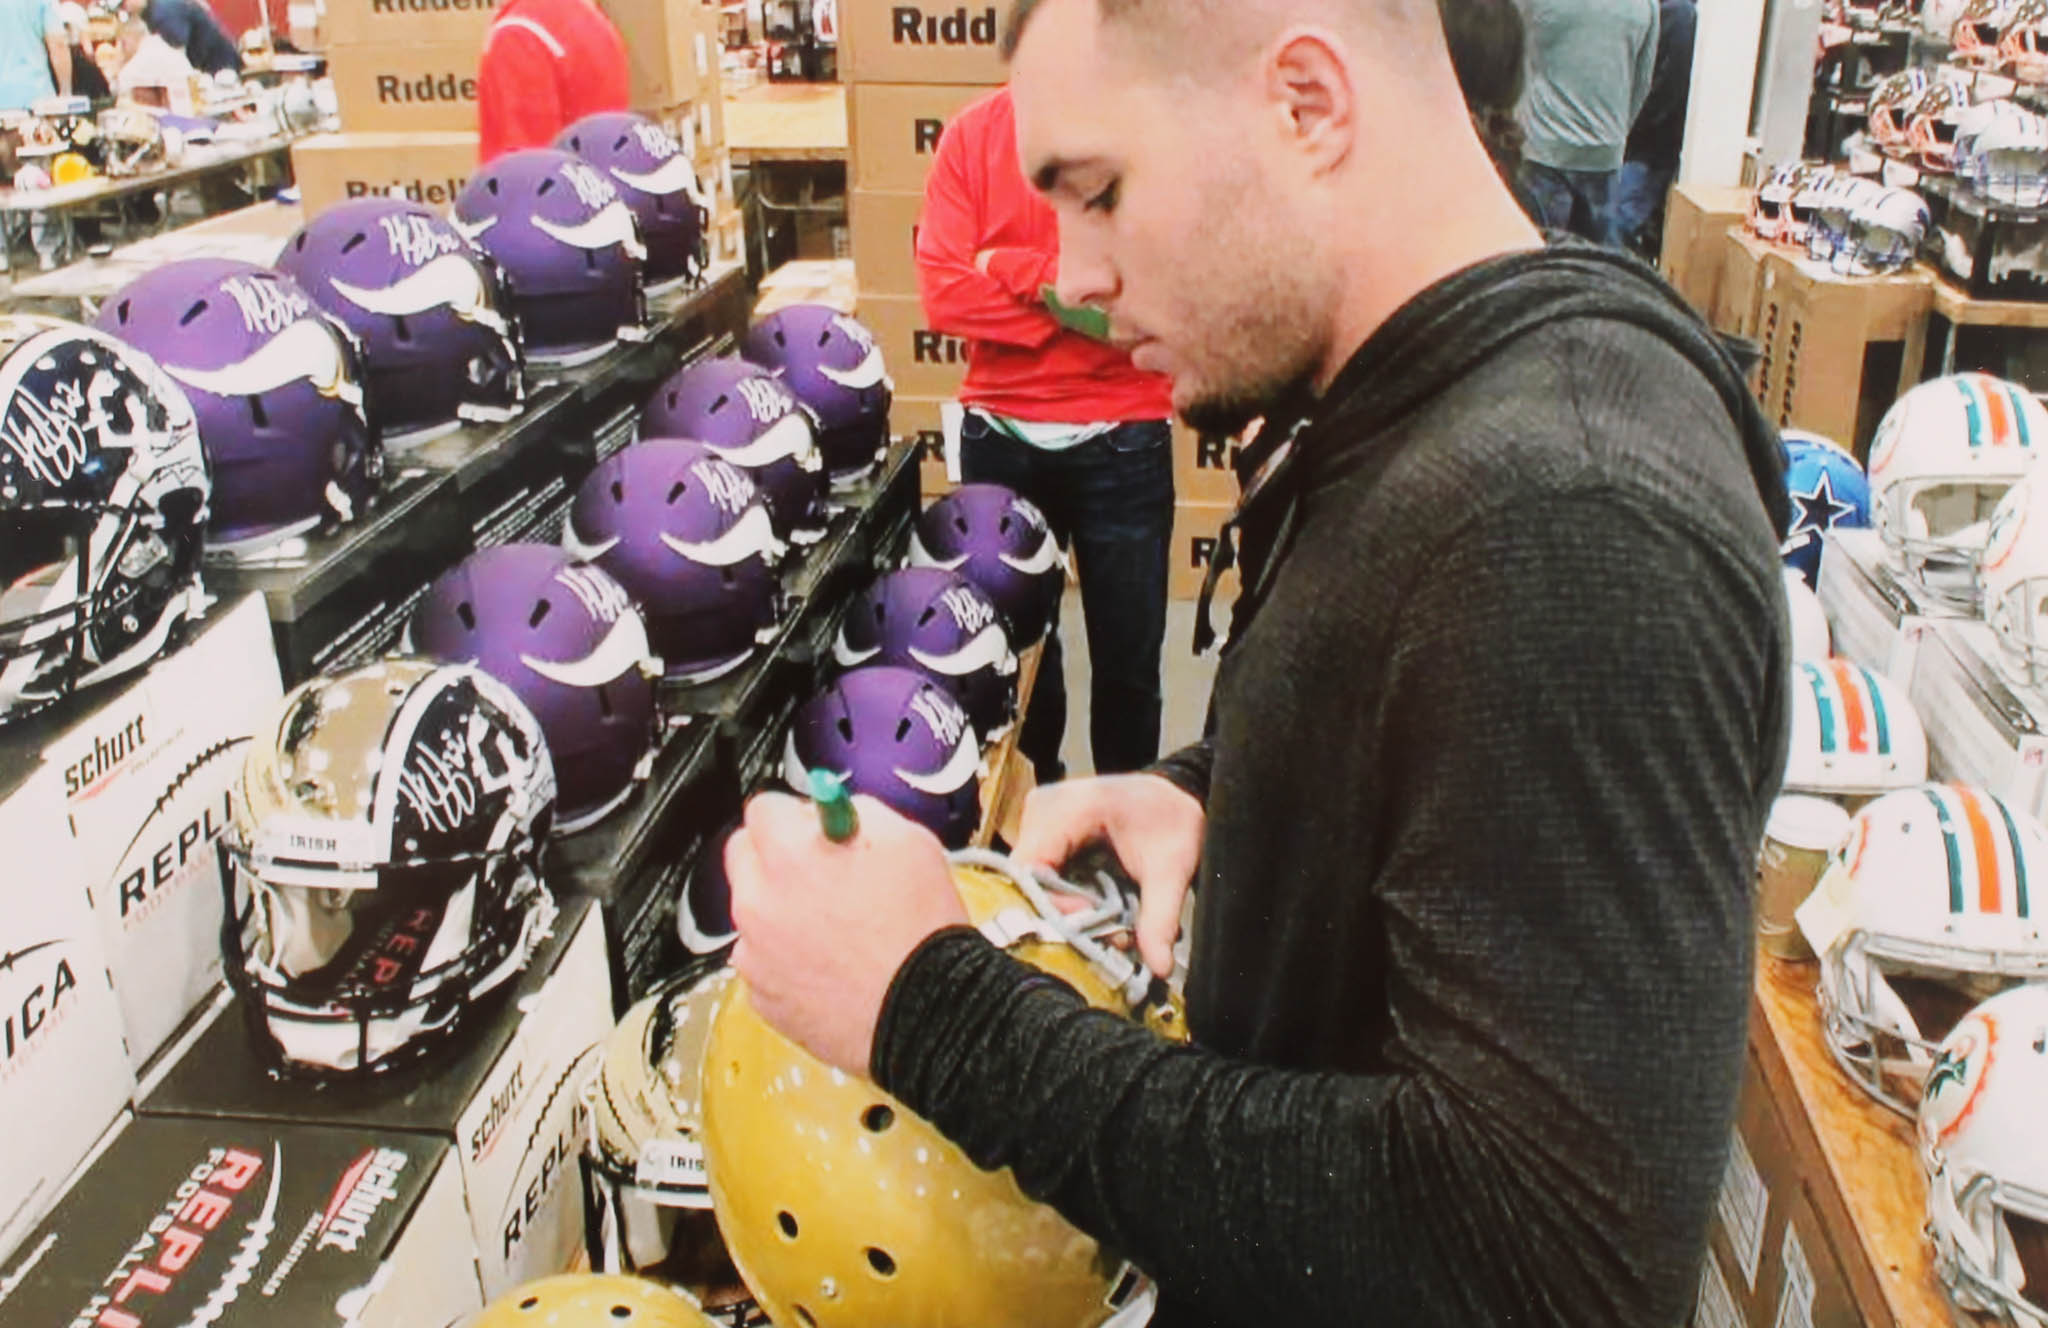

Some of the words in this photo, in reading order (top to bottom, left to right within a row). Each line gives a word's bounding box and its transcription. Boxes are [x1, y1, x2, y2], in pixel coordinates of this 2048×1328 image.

[893, 7, 996, 45] Ridd
[376, 73, 478, 103] Ridde
[290, 834, 337, 851] IRISH
[103, 1148, 226, 1287] FOOTBALL
